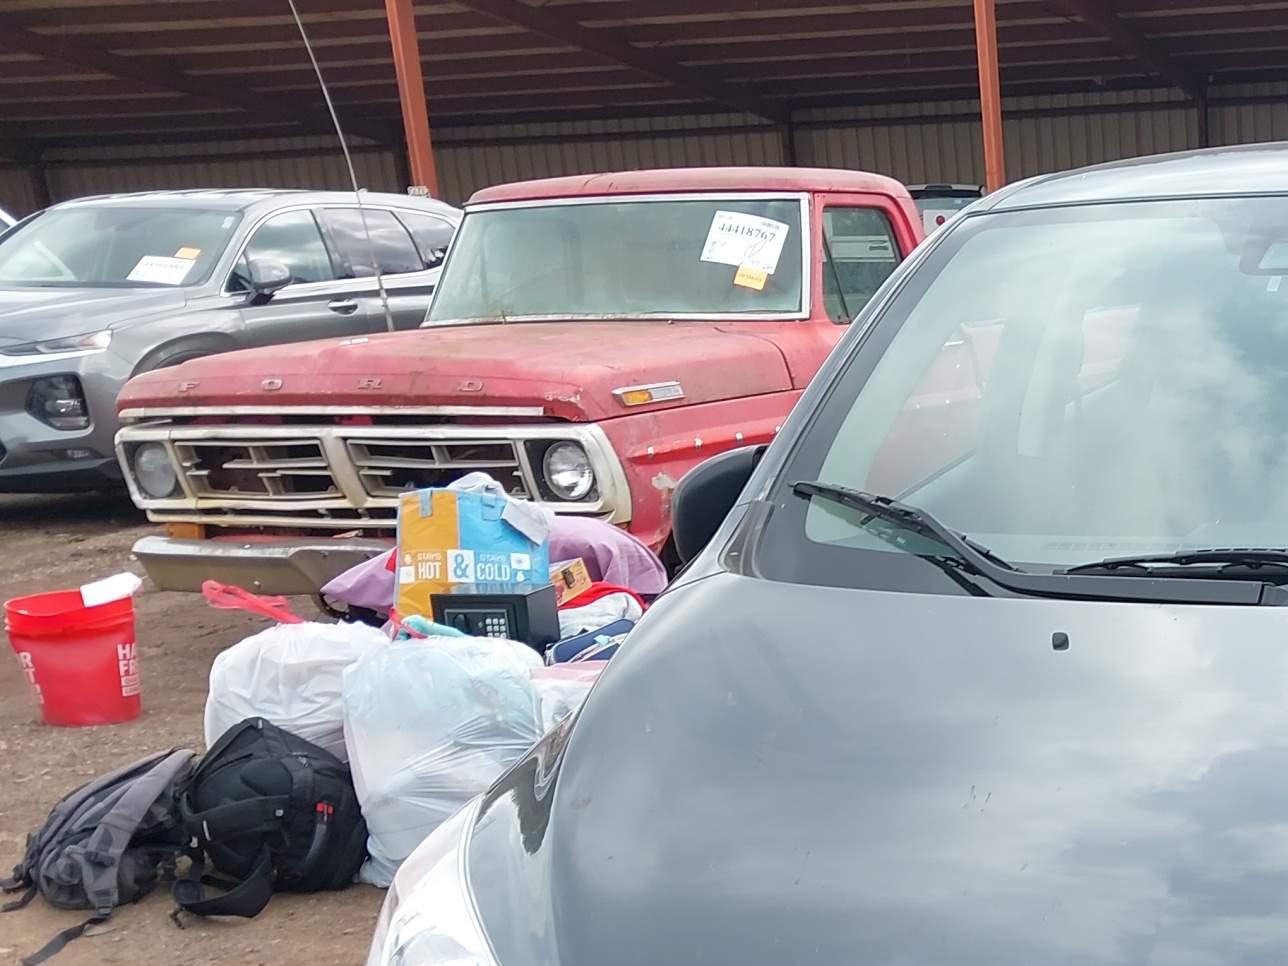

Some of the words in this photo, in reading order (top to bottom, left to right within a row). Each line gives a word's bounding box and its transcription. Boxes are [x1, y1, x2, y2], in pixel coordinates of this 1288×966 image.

[718, 223, 777, 242] 44418767
[177, 378, 484, 393] FORD
[418, 561, 442, 579] HOT
[453, 553, 470, 578] &
[476, 562, 512, 581] COLD
